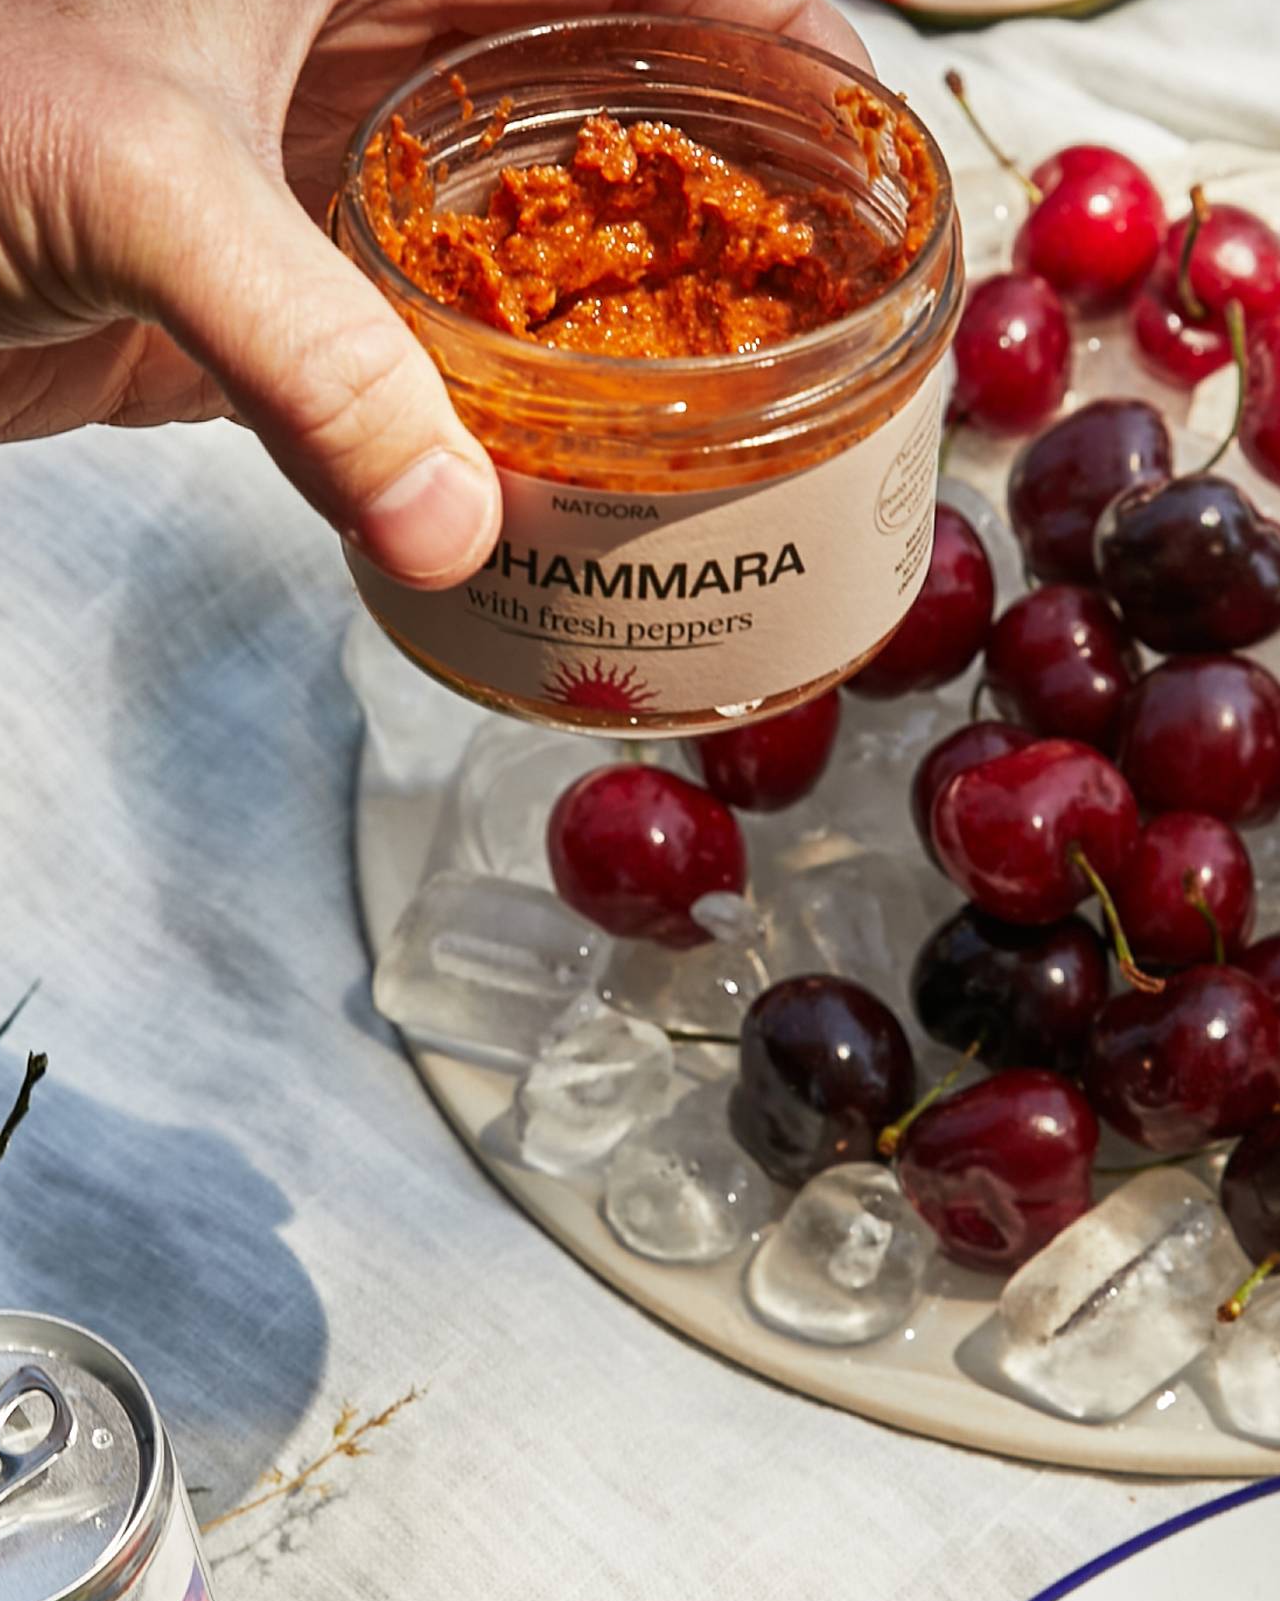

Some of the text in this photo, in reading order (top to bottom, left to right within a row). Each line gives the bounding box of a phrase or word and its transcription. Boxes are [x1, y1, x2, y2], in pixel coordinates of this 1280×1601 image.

[552, 495, 659, 520] NATOORA
[483, 540, 806, 602] HAMMARA
[466, 586, 754, 647] with fresh peppers
